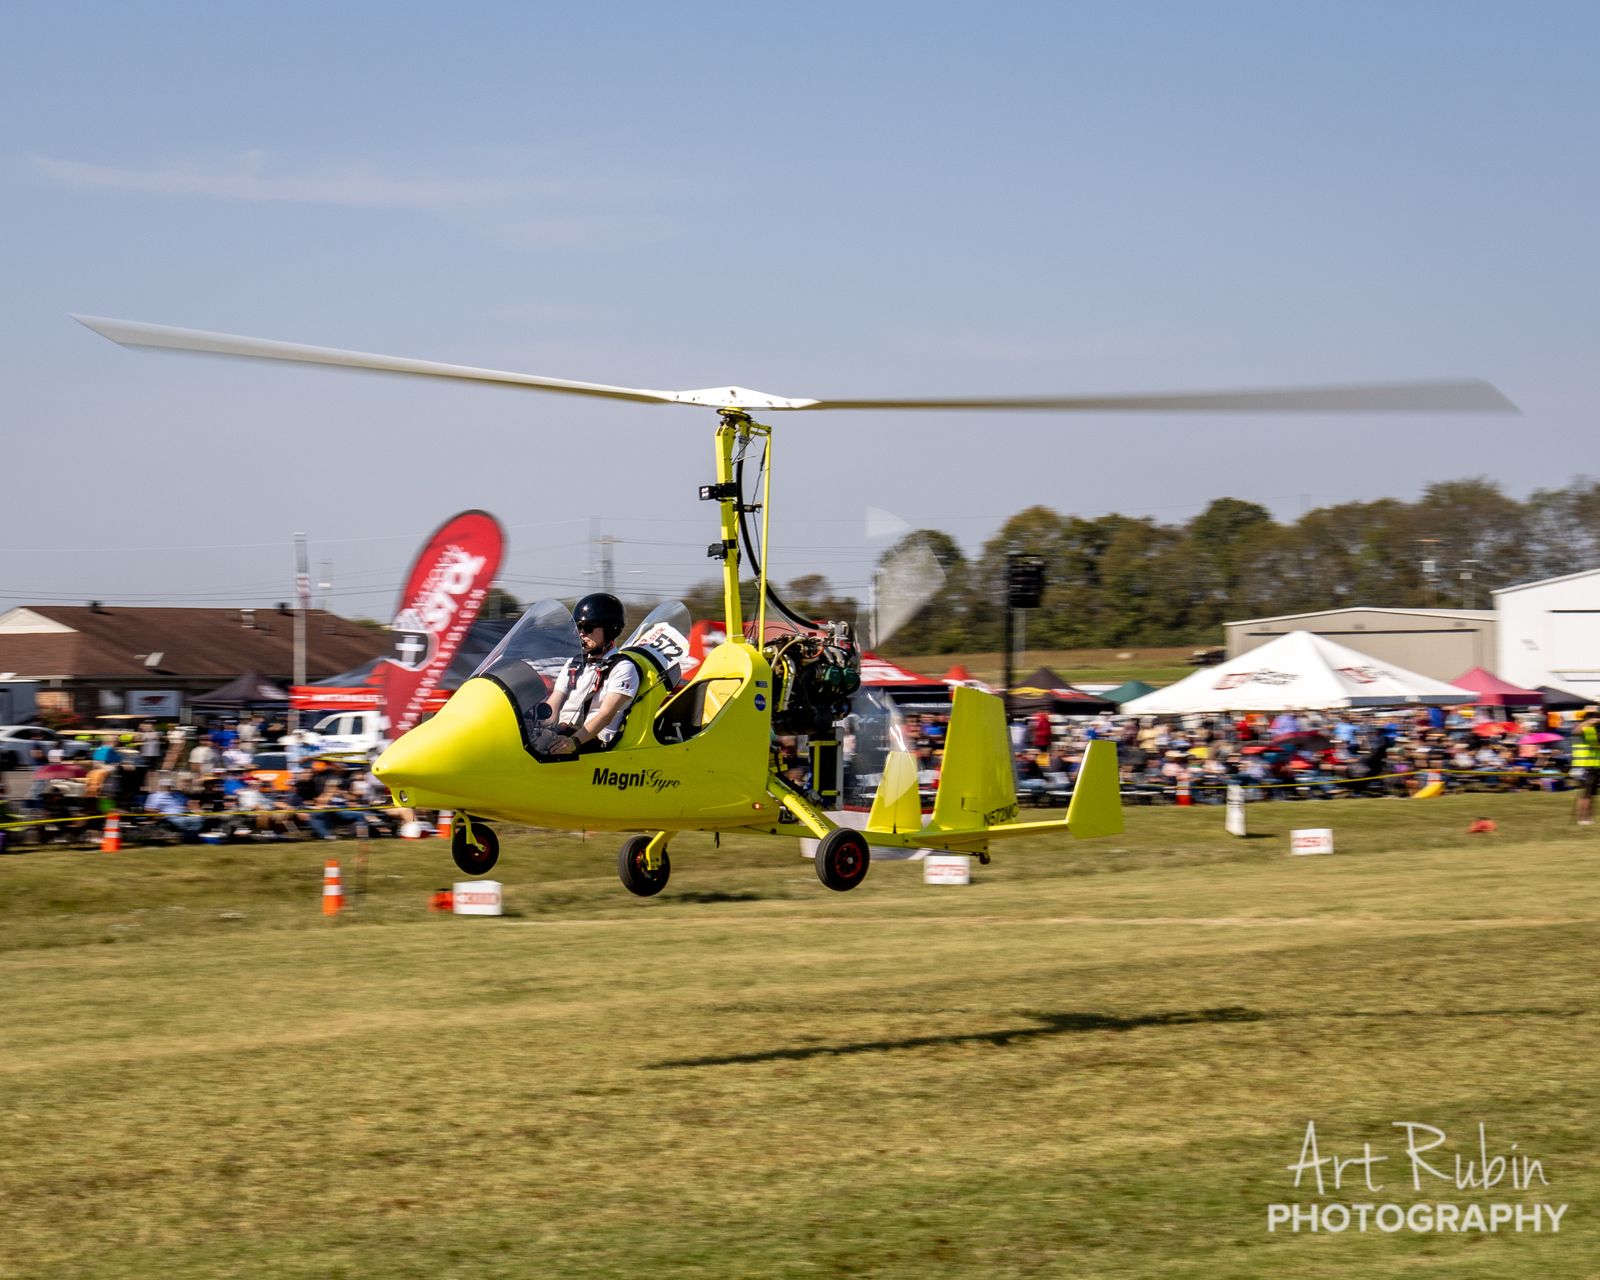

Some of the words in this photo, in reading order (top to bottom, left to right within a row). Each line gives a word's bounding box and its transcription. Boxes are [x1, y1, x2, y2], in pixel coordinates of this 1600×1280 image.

[650, 633, 683, 662] 572
[592, 767, 646, 791] Magni
[646, 768, 680, 794] Gyro
